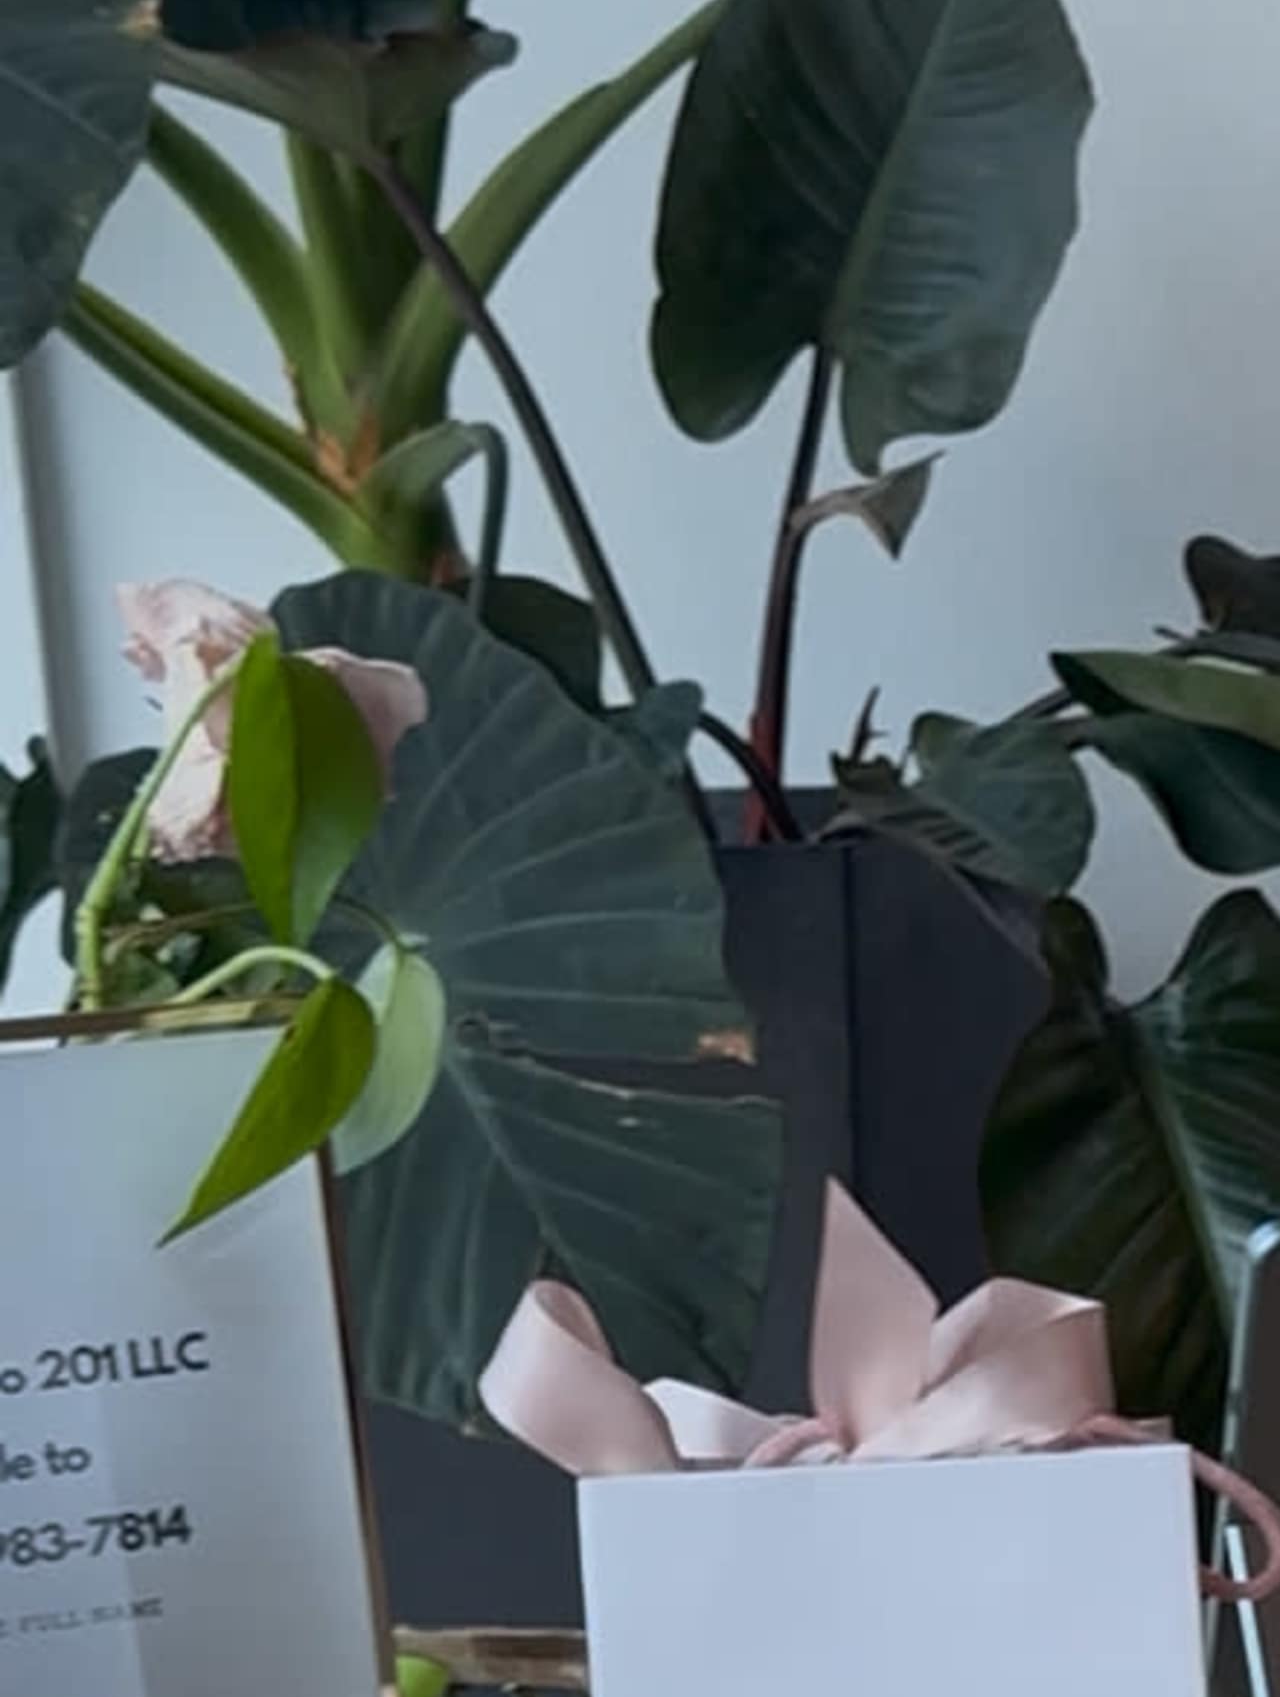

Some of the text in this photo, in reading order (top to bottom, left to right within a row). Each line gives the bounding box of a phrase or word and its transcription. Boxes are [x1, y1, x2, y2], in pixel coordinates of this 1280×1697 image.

[37, 1344, 120, 1390] 201
[127, 1332, 211, 1378] LLC
[43, 1440, 91, 1476] to
